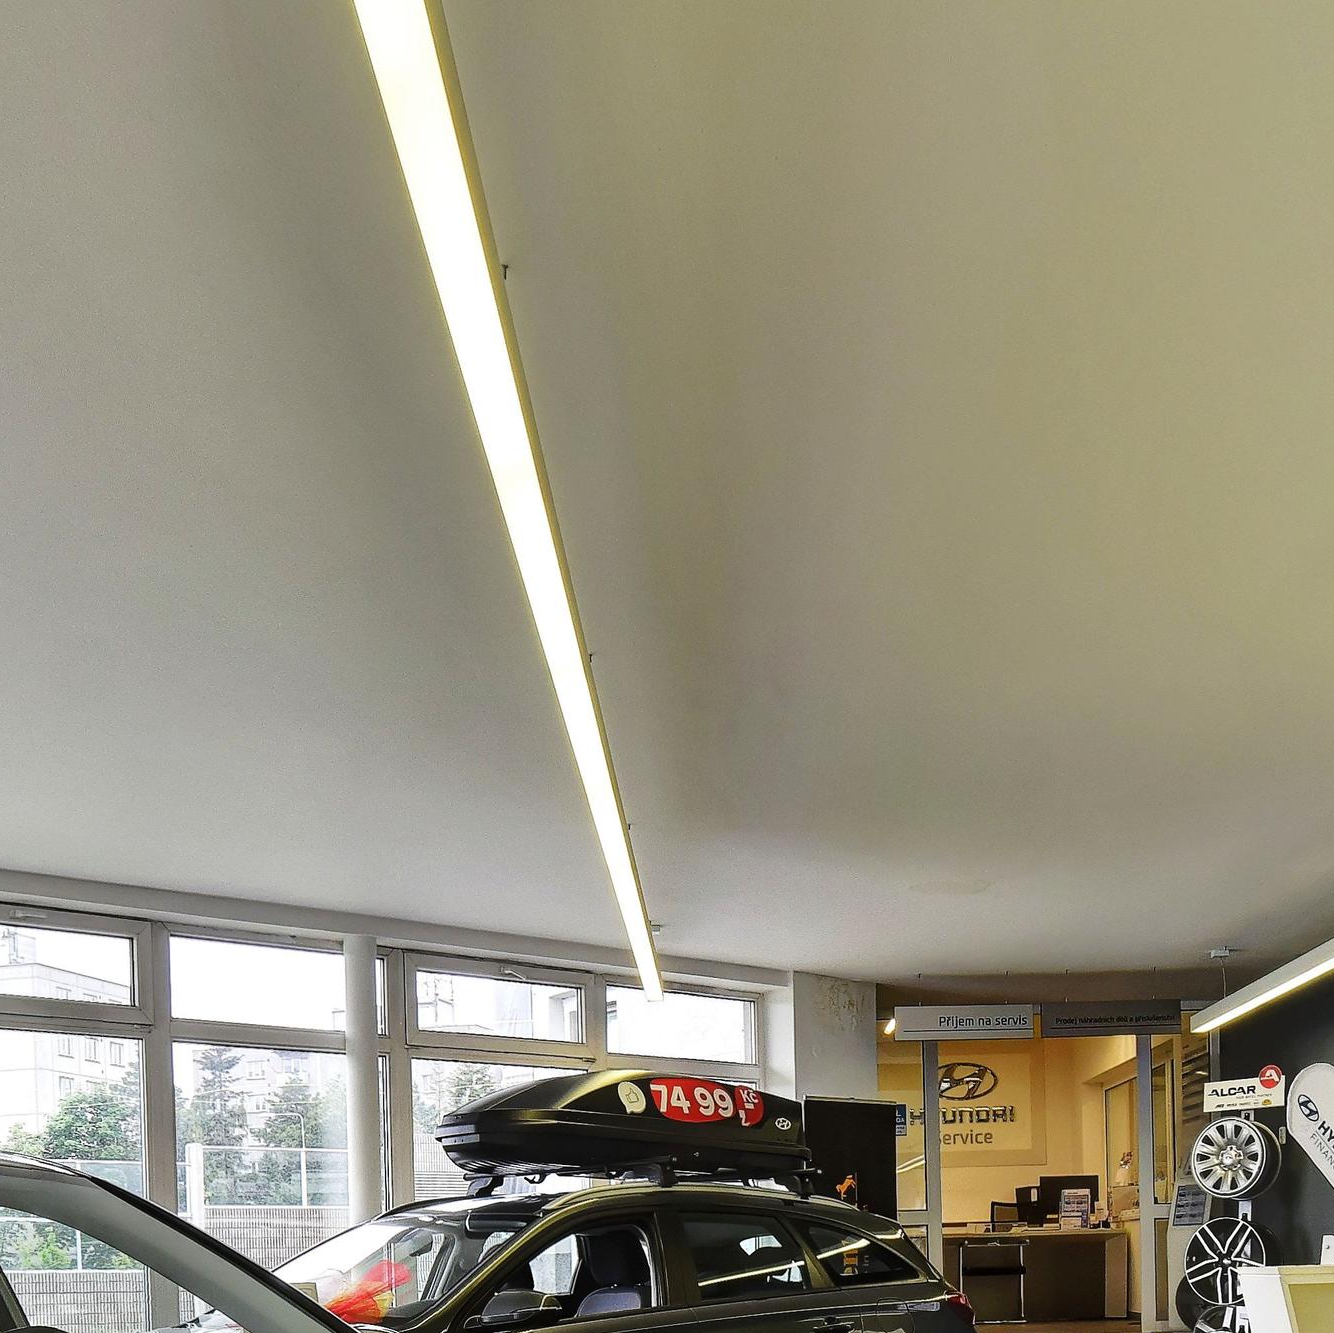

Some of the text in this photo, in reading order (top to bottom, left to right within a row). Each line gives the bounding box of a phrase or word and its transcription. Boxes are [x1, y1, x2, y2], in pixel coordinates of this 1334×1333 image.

[939, 1014, 1027, 1028] Příjem na servis
[1208, 1085, 1256, 1097] ALCAR
[939, 1130, 993, 1145] ervice
